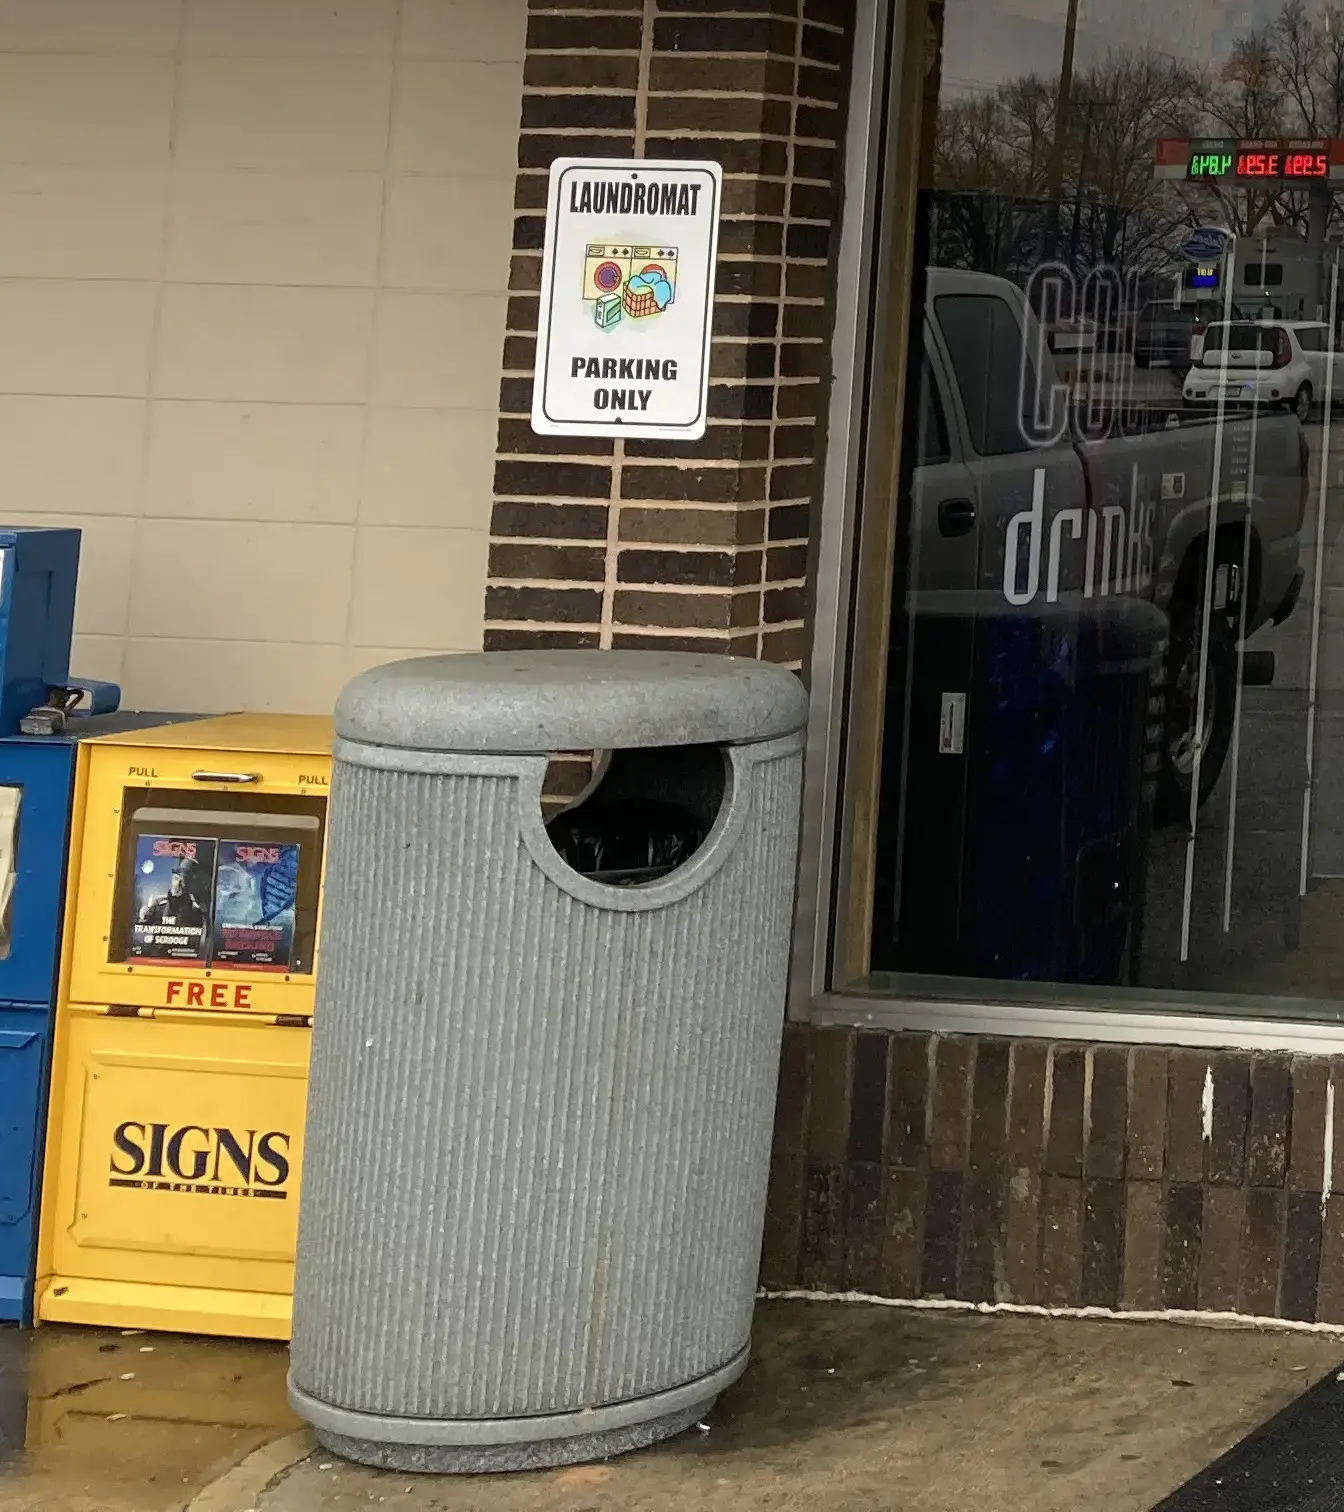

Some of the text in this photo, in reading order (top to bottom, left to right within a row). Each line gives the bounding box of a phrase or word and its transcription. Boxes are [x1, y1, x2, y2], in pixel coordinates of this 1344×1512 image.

[570, 181, 702, 216] LAUNDROMAT
[571, 357, 678, 381] PARKING
[593, 388, 653, 411] ONLY
[1003, 466, 1156, 607] drinks
[128, 766, 329, 785] PULL PULL
[152, 840, 198, 858] SIGNS
[235, 846, 281, 864] SIGNS
[134, 924, 203, 936] TRANSFORMATION
[161, 915, 177, 926] THE
[144, 935, 153, 945] OF
[165, 981, 252, 1009] FREE
[110, 1121, 291, 1186] SIGNS
[169, 1182, 197, 1193] THE
